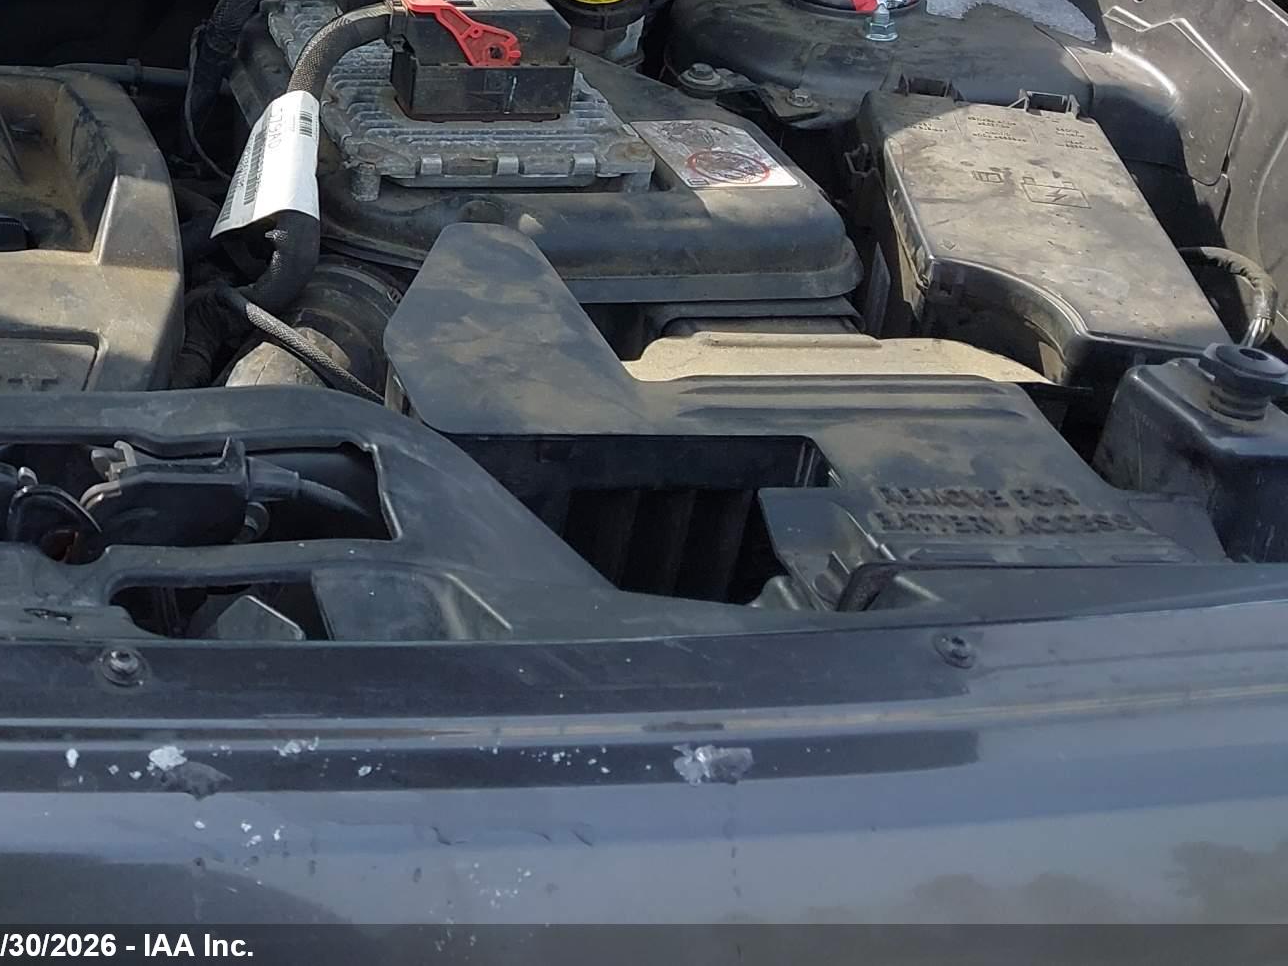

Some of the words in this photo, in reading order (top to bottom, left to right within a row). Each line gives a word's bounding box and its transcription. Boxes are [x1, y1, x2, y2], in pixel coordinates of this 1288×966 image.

[875, 486, 1009, 507] REMOVE
[1012, 487, 1080, 507] FOR
[872, 512, 1006, 534] BATTERY
[1012, 513, 1137, 534] ACCESS
